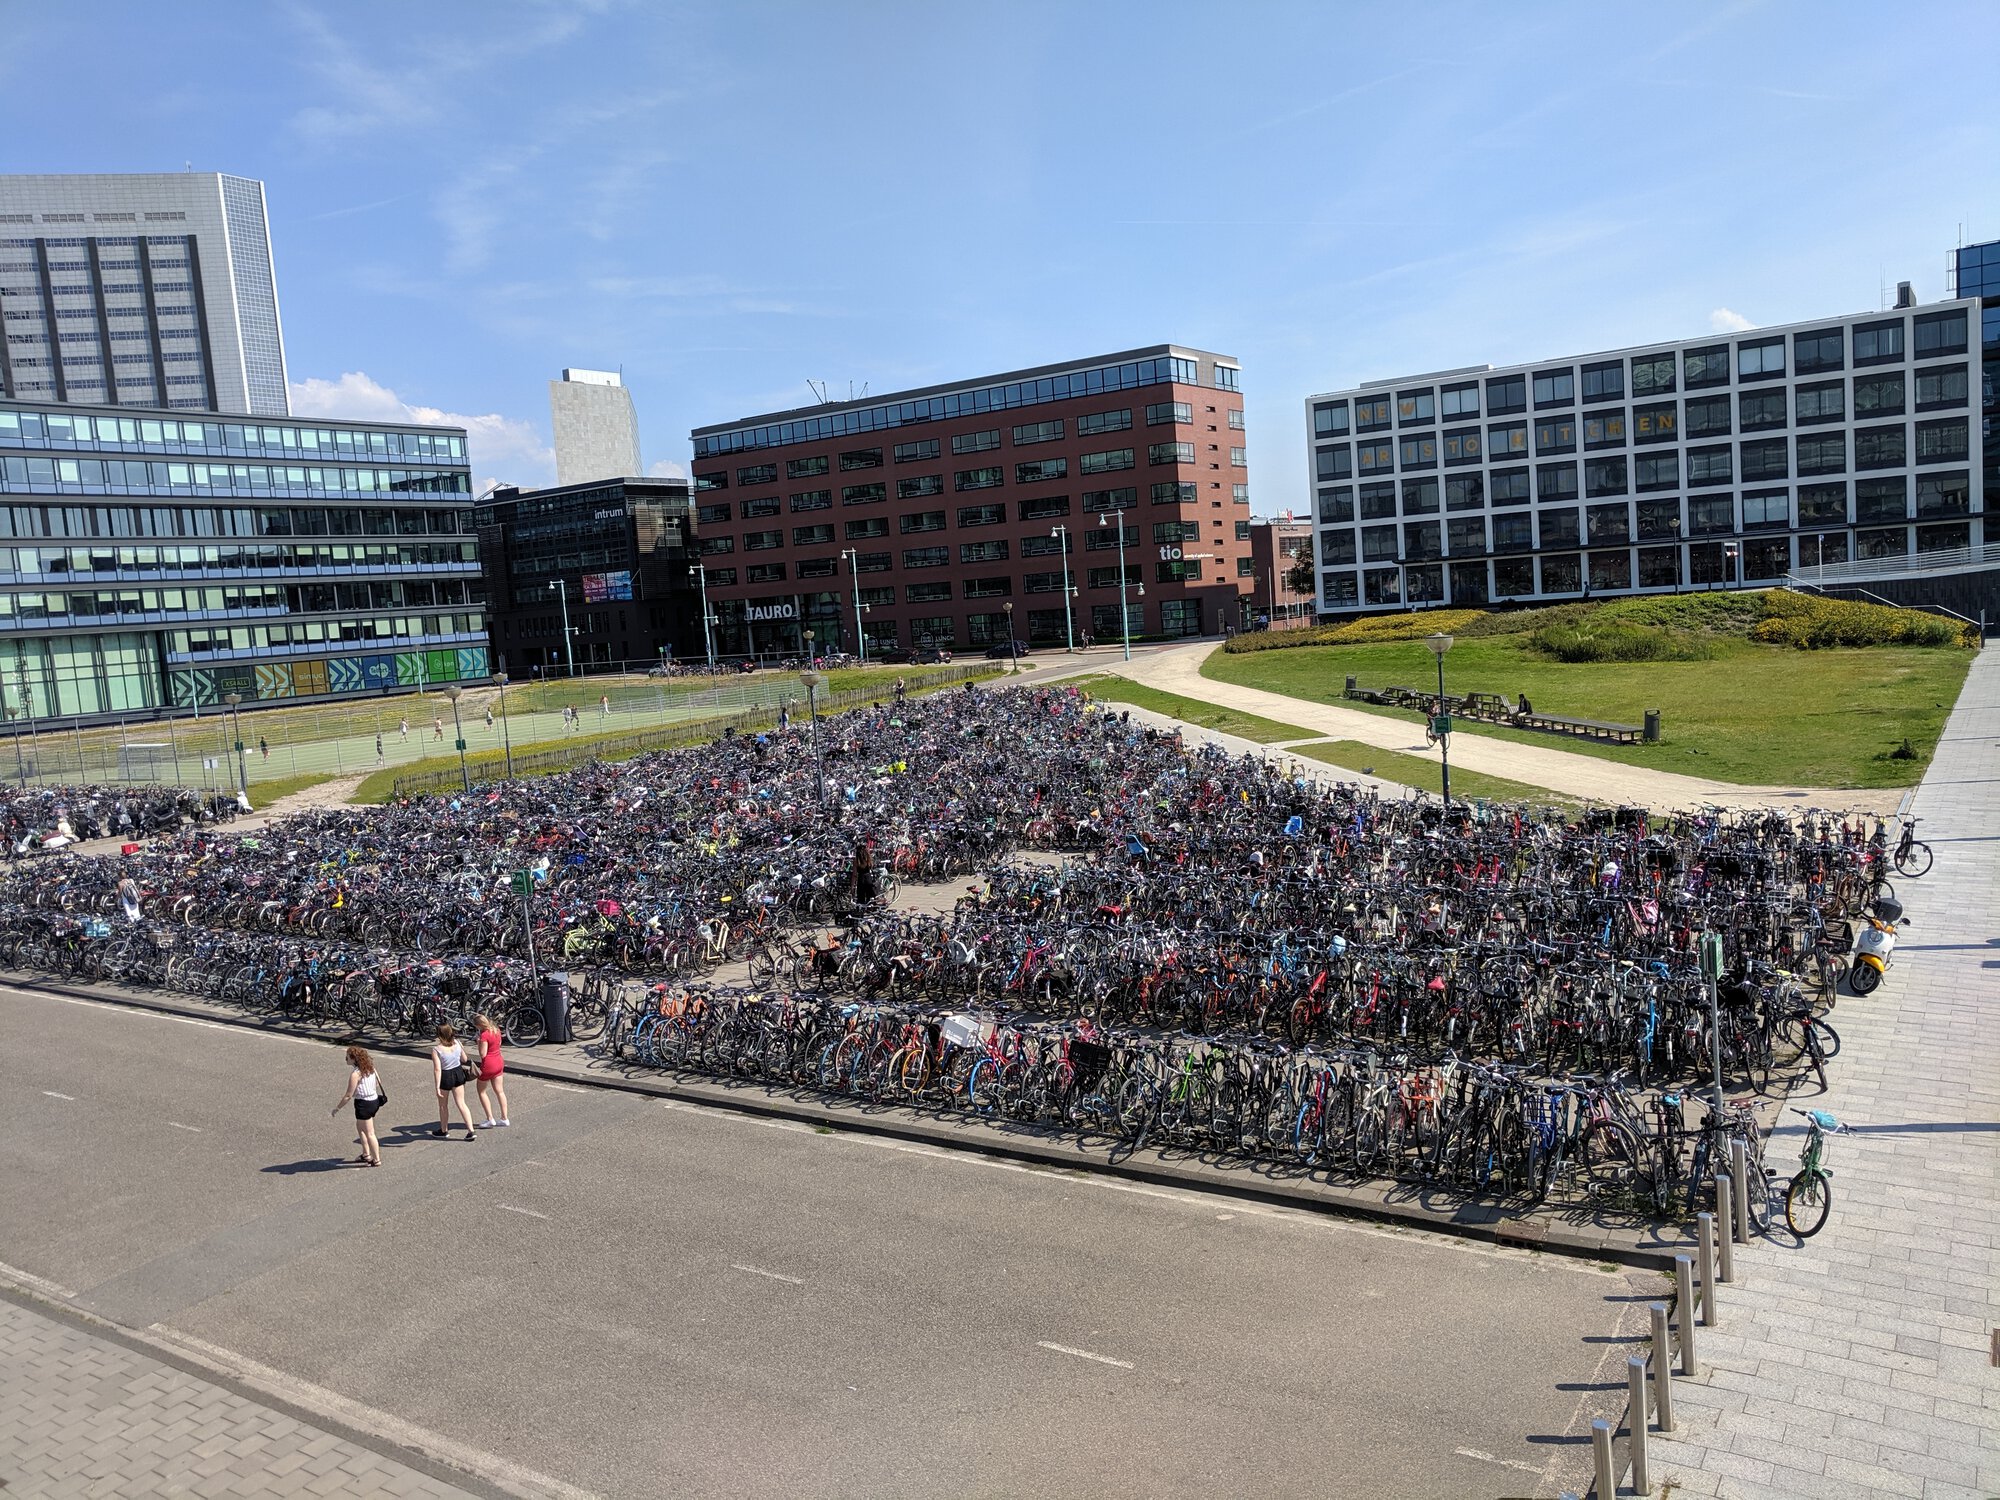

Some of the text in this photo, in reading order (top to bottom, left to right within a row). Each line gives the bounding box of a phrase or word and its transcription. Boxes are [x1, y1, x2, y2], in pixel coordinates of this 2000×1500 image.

[1360, 401, 1414, 420] NEW
[1362, 415, 1673, 464] ARISTO KITCHEN
[594, 508, 623, 520] intrum
[1159, 544, 1182, 561] tio
[746, 603, 793, 620] TAURO
